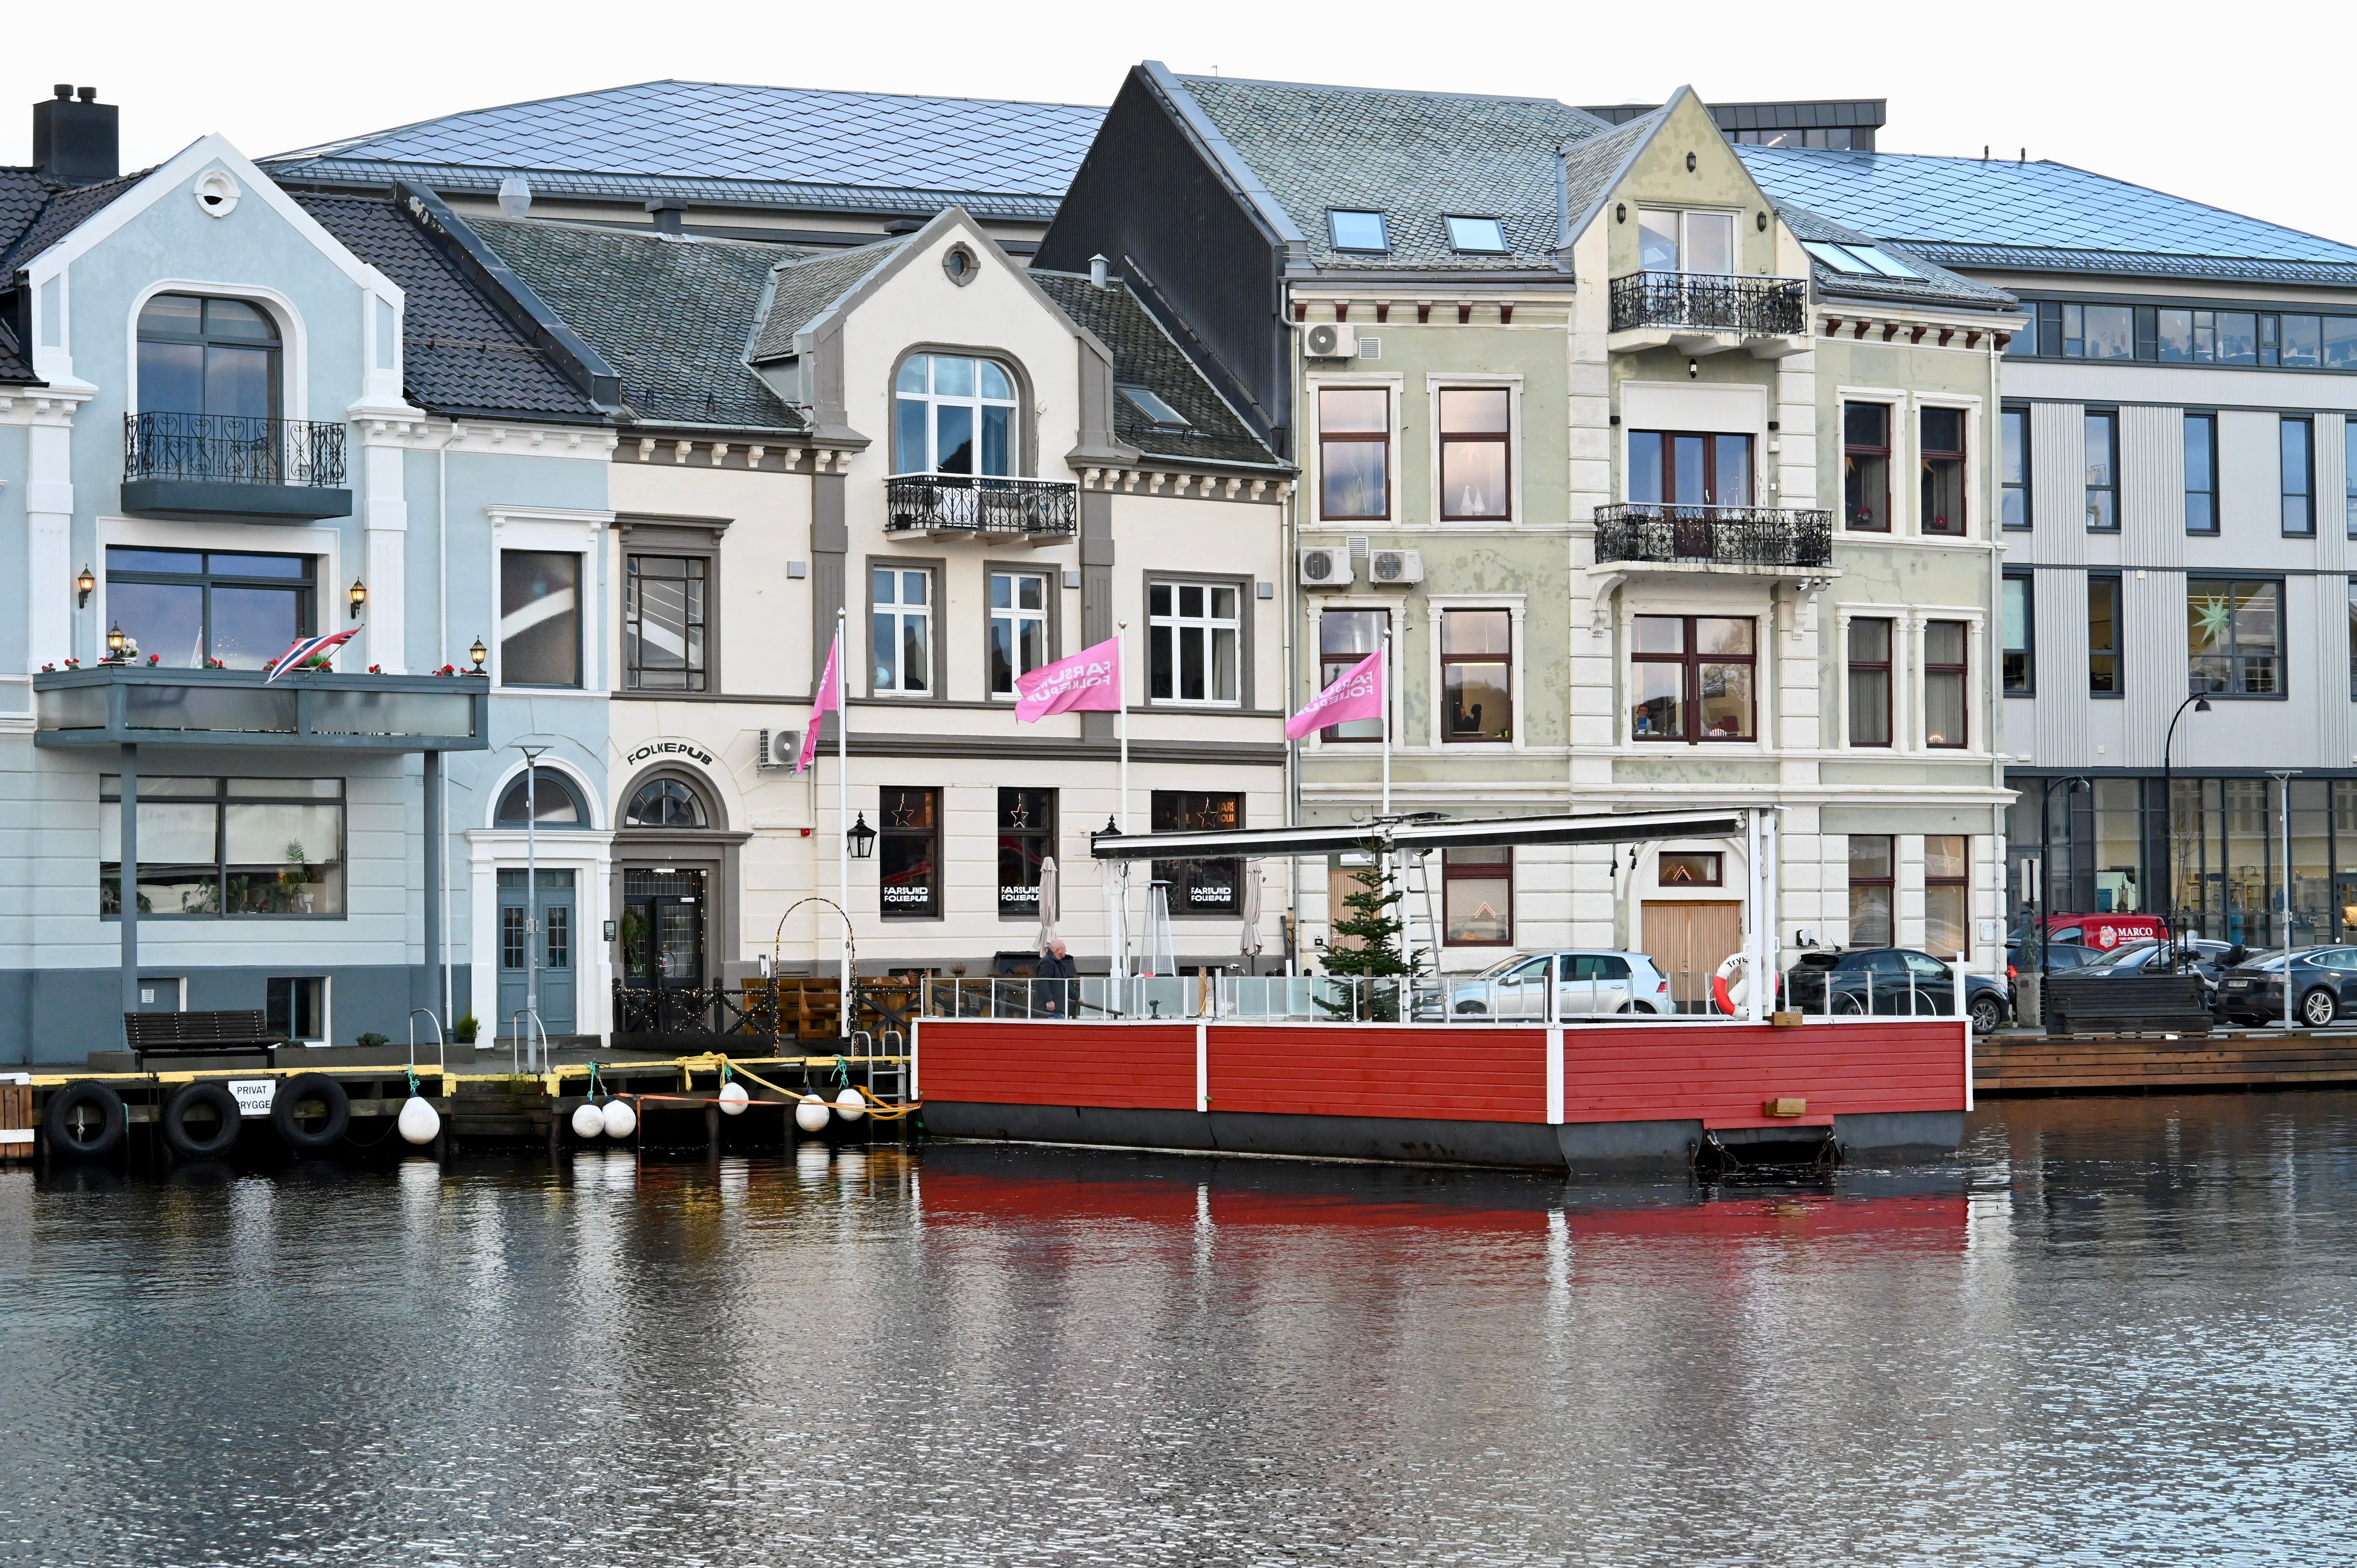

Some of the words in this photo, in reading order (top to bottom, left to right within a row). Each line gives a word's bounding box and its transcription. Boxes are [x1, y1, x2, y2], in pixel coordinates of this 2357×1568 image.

[627, 743, 713, 766] FOLKEPUB
[2118, 927, 2153, 936] MARCO
[237, 1086, 267, 1095] PRIVAT
[240, 1100, 270, 1109] RYGGE
